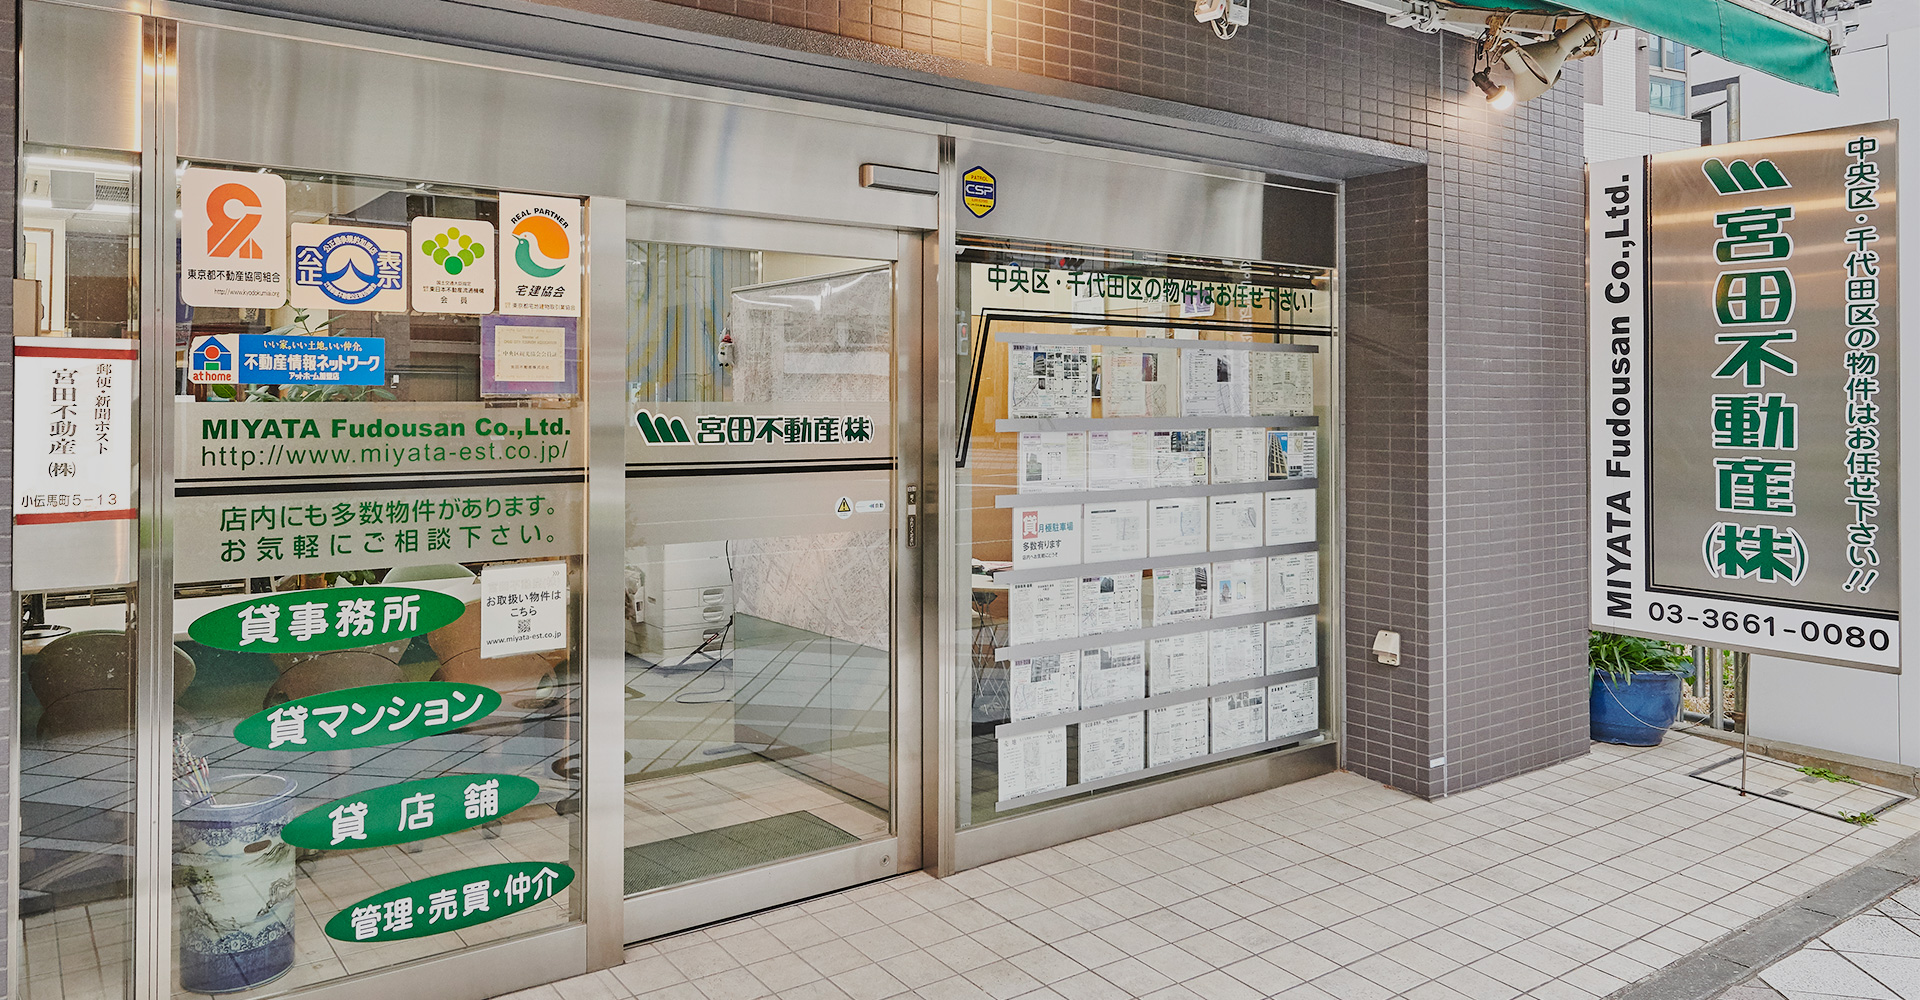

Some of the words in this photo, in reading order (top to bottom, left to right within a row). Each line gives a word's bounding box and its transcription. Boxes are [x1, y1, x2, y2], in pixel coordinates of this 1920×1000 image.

[966, 184, 993, 196] CSP
[511, 208, 532, 225] REAL
[534, 207, 569, 229] PARTNER
[1604, 174, 1636, 304] Co.,Ltd.
[187, 268, 281, 283] 東京都不動産協同組合
[297, 247, 323, 285] 公正
[376, 251, 402, 289] 表示
[515, 284, 566, 298] 宅建協会
[243, 353, 380, 372] 不動産情報ネットワーク
[263, 339, 363, 352] いい家。いい土地。いい仲介。
[94, 363, 112, 455] 郵便・新聞ポスト
[1605, 316, 1631, 478] Fudousan
[202, 418, 321, 440] MIYATA
[331, 417, 466, 438] Fudousan
[475, 416, 571, 440] Co.,Ltd.
[201, 440, 569, 471] http://www.miyata-est.co.jp/
[220, 495, 555, 533] 店内にも多数物件があります。
[221, 524, 555, 563] お気軽にご相談下さい。
[1022, 539, 1062, 552] 多数有ります
[1606, 491, 1632, 619] MIYATA
[486, 590, 561, 608] お取扱い物件は
[510, 606, 537, 617] こちら
[237, 594, 422, 647] 貸事務所
[486, 630, 562, 645] www.miyata-est.co.jp
[1648, 602, 1890, 651] 03-3661-0080
[267, 690, 485, 750] 貸マンション
[350, 866, 559, 941] 管理・売買・仲介
